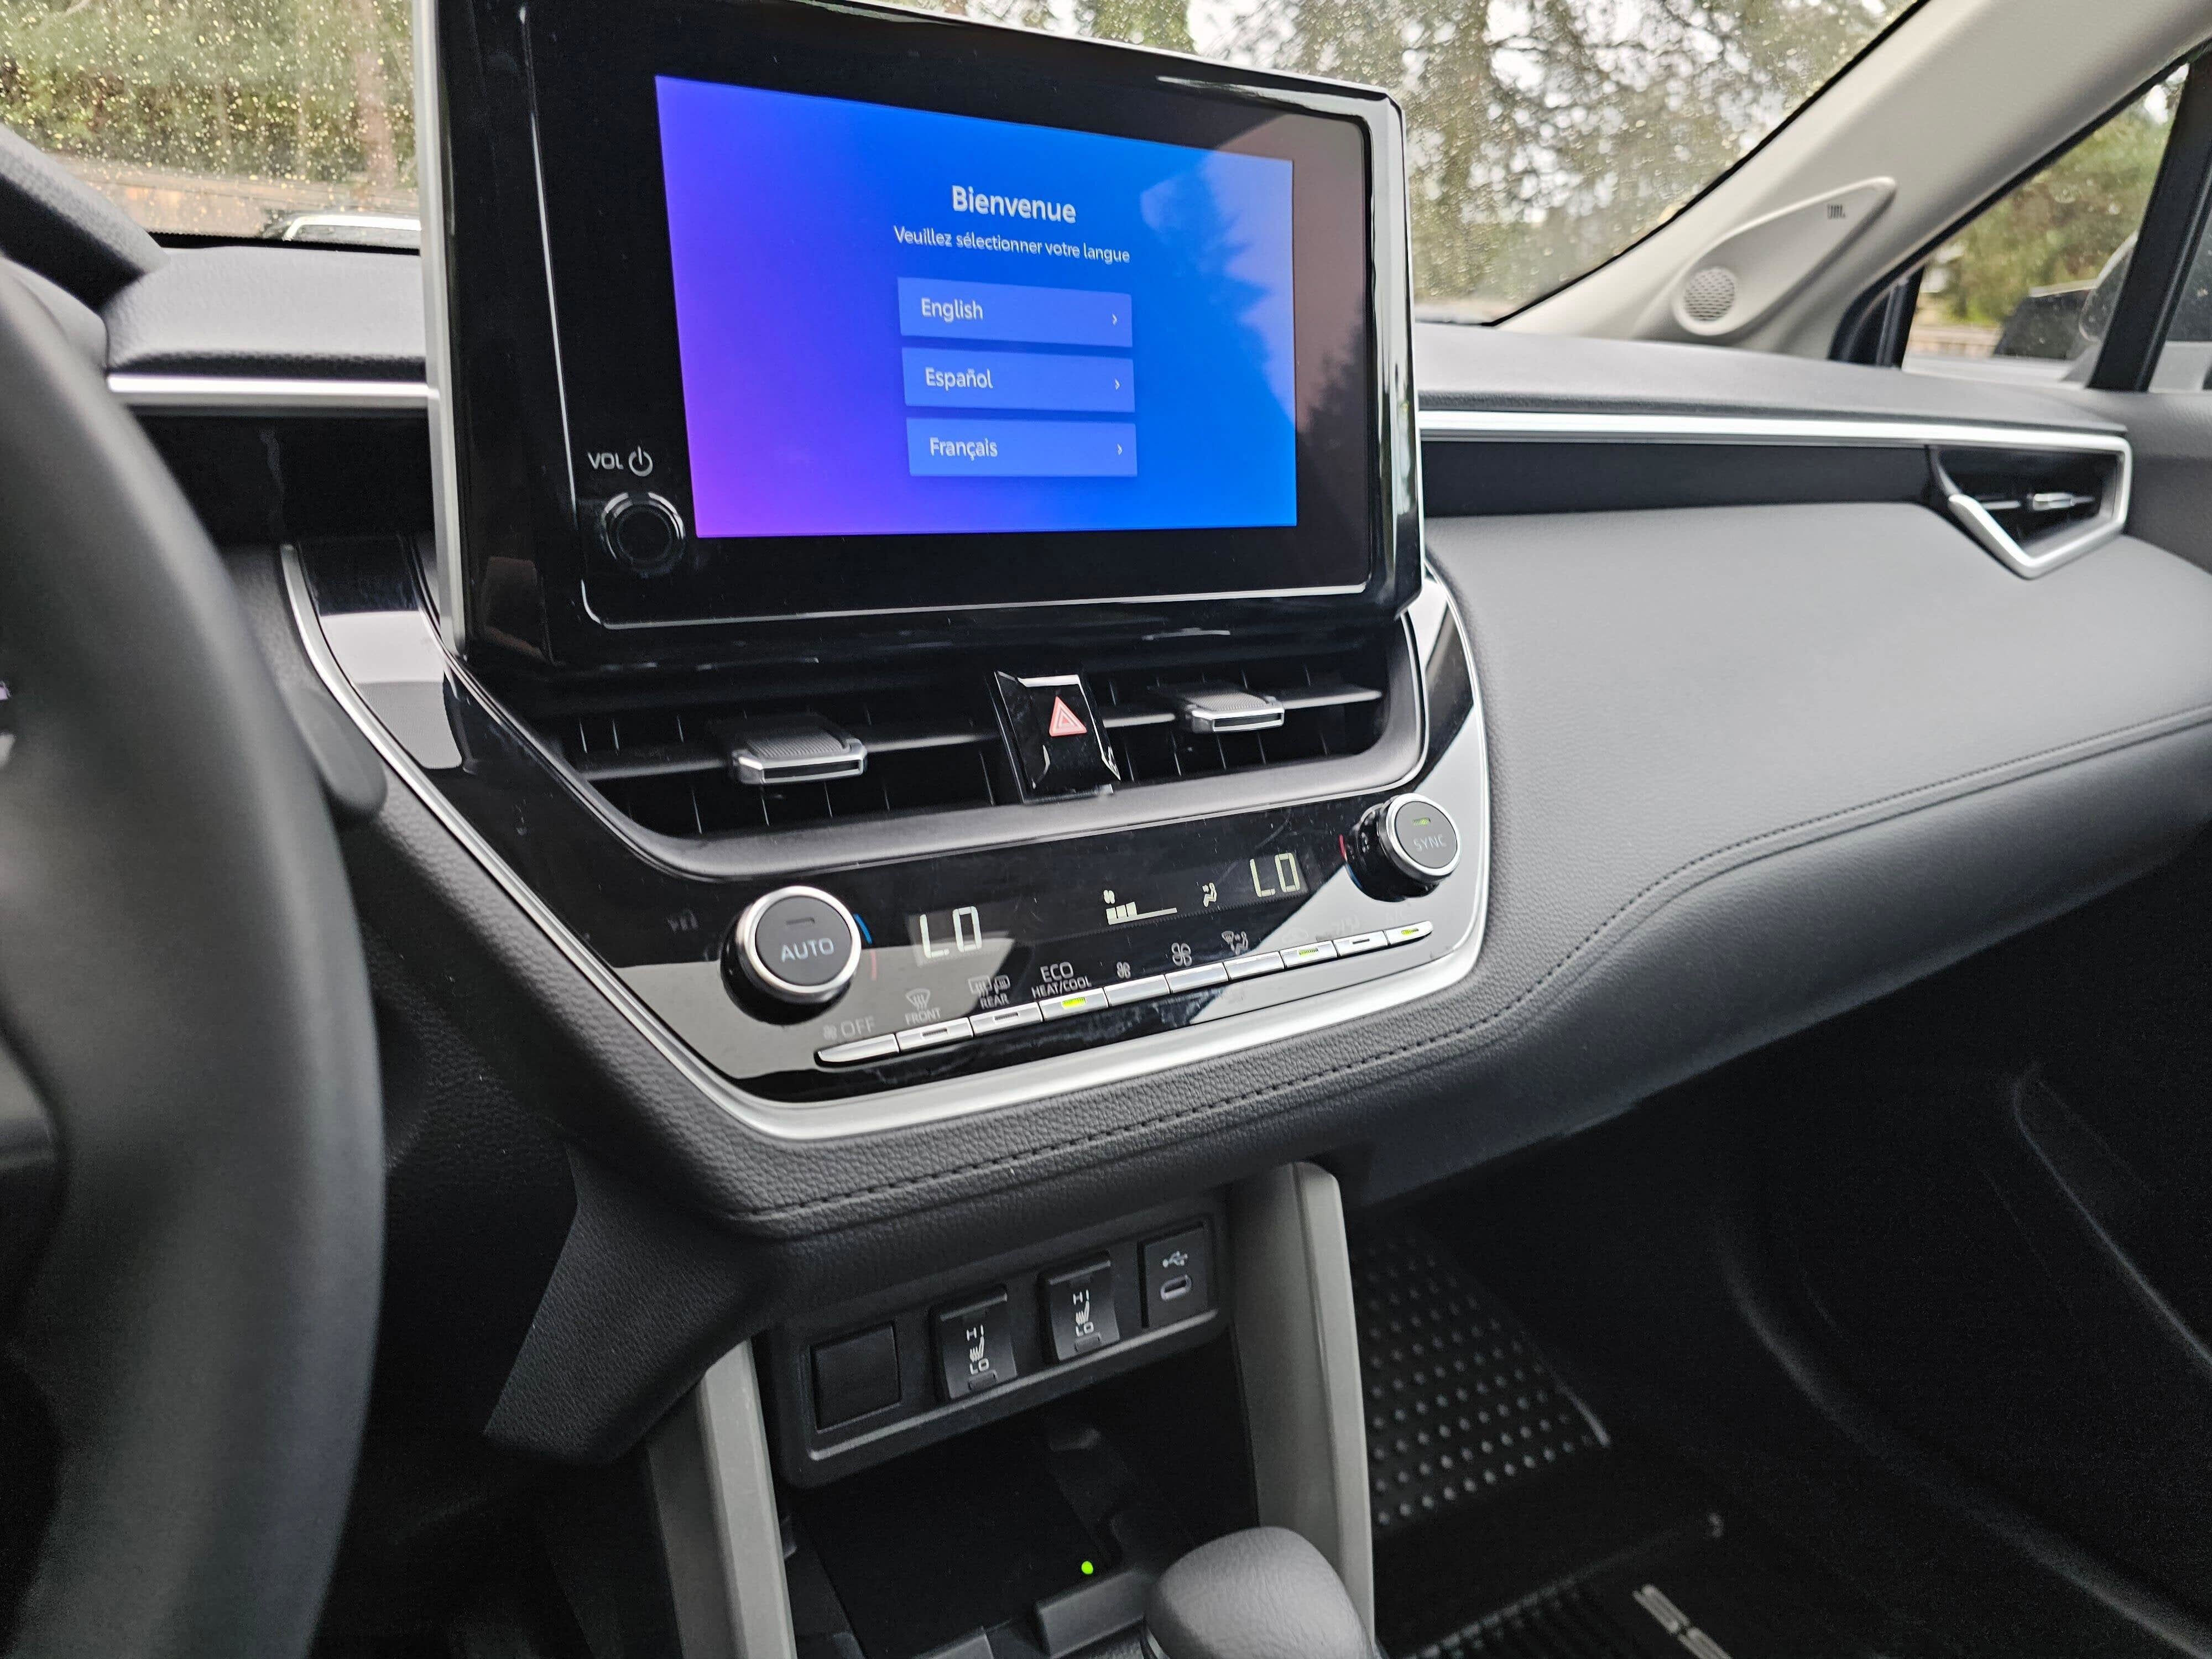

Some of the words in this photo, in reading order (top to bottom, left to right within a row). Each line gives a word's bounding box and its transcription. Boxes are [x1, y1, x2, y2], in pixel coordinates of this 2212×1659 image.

[952, 185, 1077, 223] Bienvenue
[894, 225, 952, 247] Veuillez
[956, 232, 1042, 254] sélectionner
[1045, 242, 1080, 259] votre
[1083, 243, 1130, 265] langue
[921, 297, 984, 322] English
[925, 367, 994, 390] Español
[929, 437, 998, 461] Français
[587, 452, 624, 469] VOL
[1413, 833, 1447, 852] SYNC
[1250, 852, 1301, 897] LO
[920, 906, 982, 959] LO
[780, 938, 835, 962] AUTO
[1040, 961, 1074, 983] ECO
[1031, 976, 1092, 999] HEAT/COOL
[980, 992, 1011, 1009] REAR
[841, 1016, 875, 1038] OFF
[905, 1008, 941, 1026] FRONT
[1073, 1288, 1089, 1306] HI
[966, 1324, 984, 1342] HI
[1076, 1322, 1094, 1337] LO
[969, 1358, 989, 1375] LO
